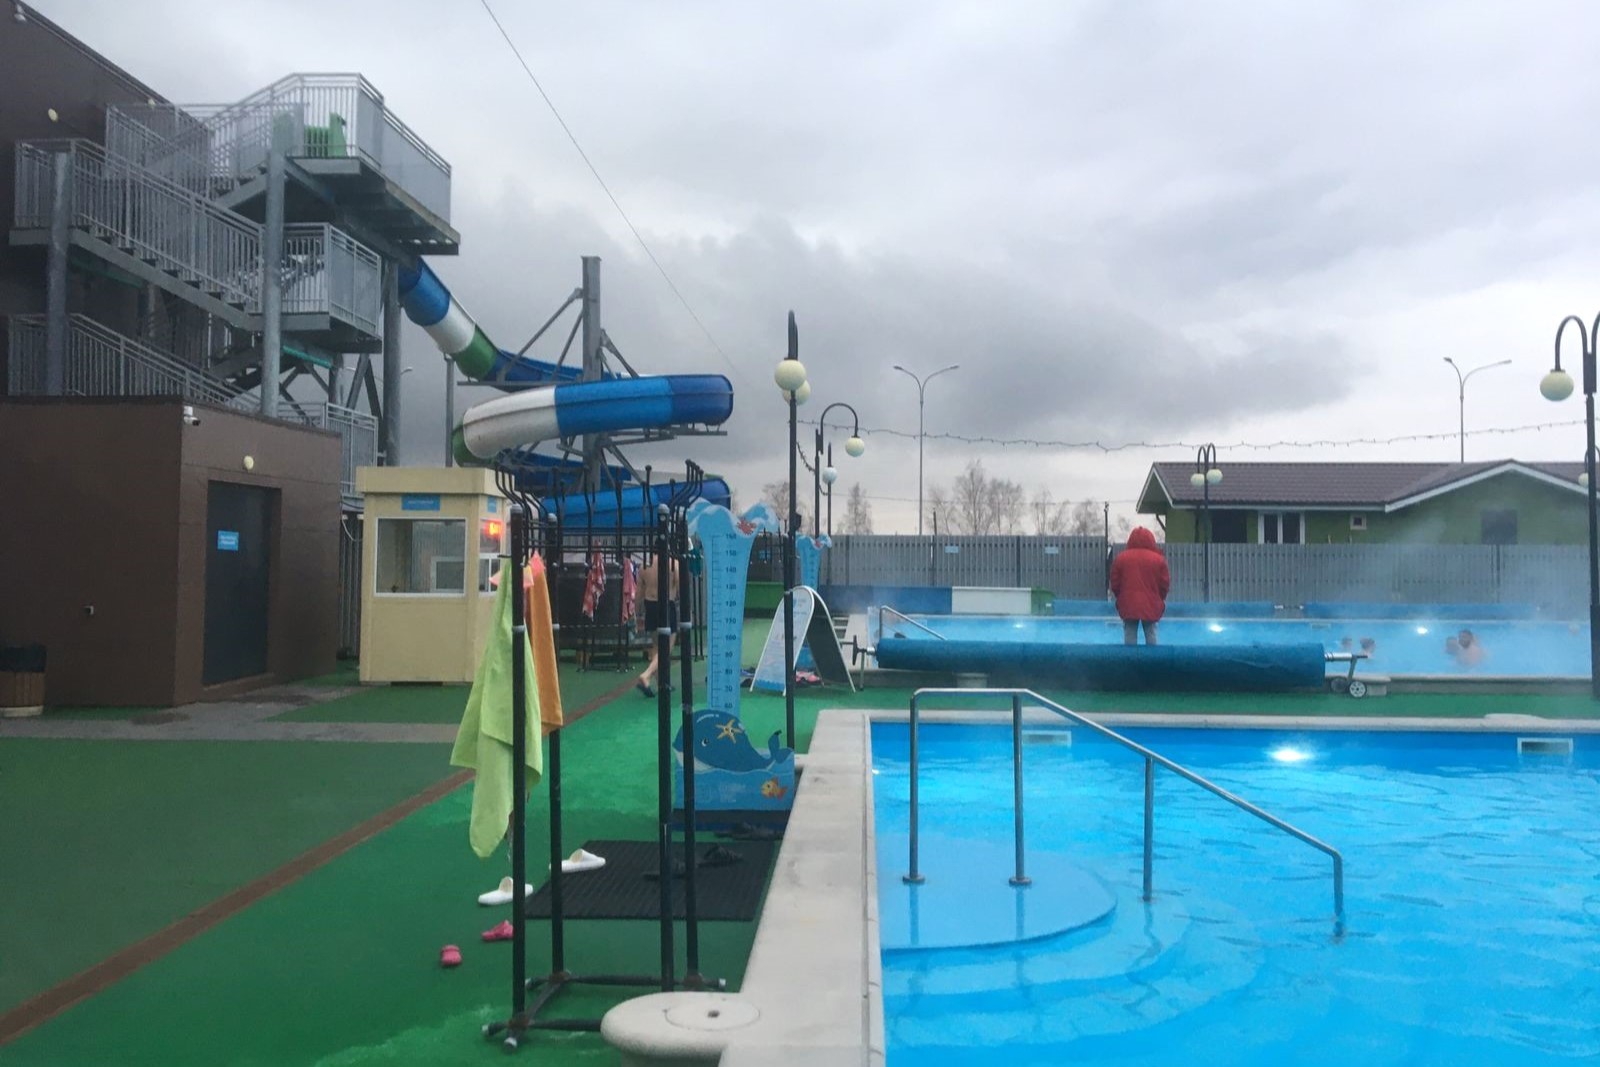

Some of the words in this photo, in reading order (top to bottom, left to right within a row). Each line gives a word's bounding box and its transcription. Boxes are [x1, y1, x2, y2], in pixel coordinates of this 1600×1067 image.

[726, 566, 737, 574] 140
[726, 600, 737, 608] 120
[725, 617, 737, 625] 110
[725, 634, 737, 642] 100
[725, 651, 733, 659] 90
[725, 685, 733, 693] 70
